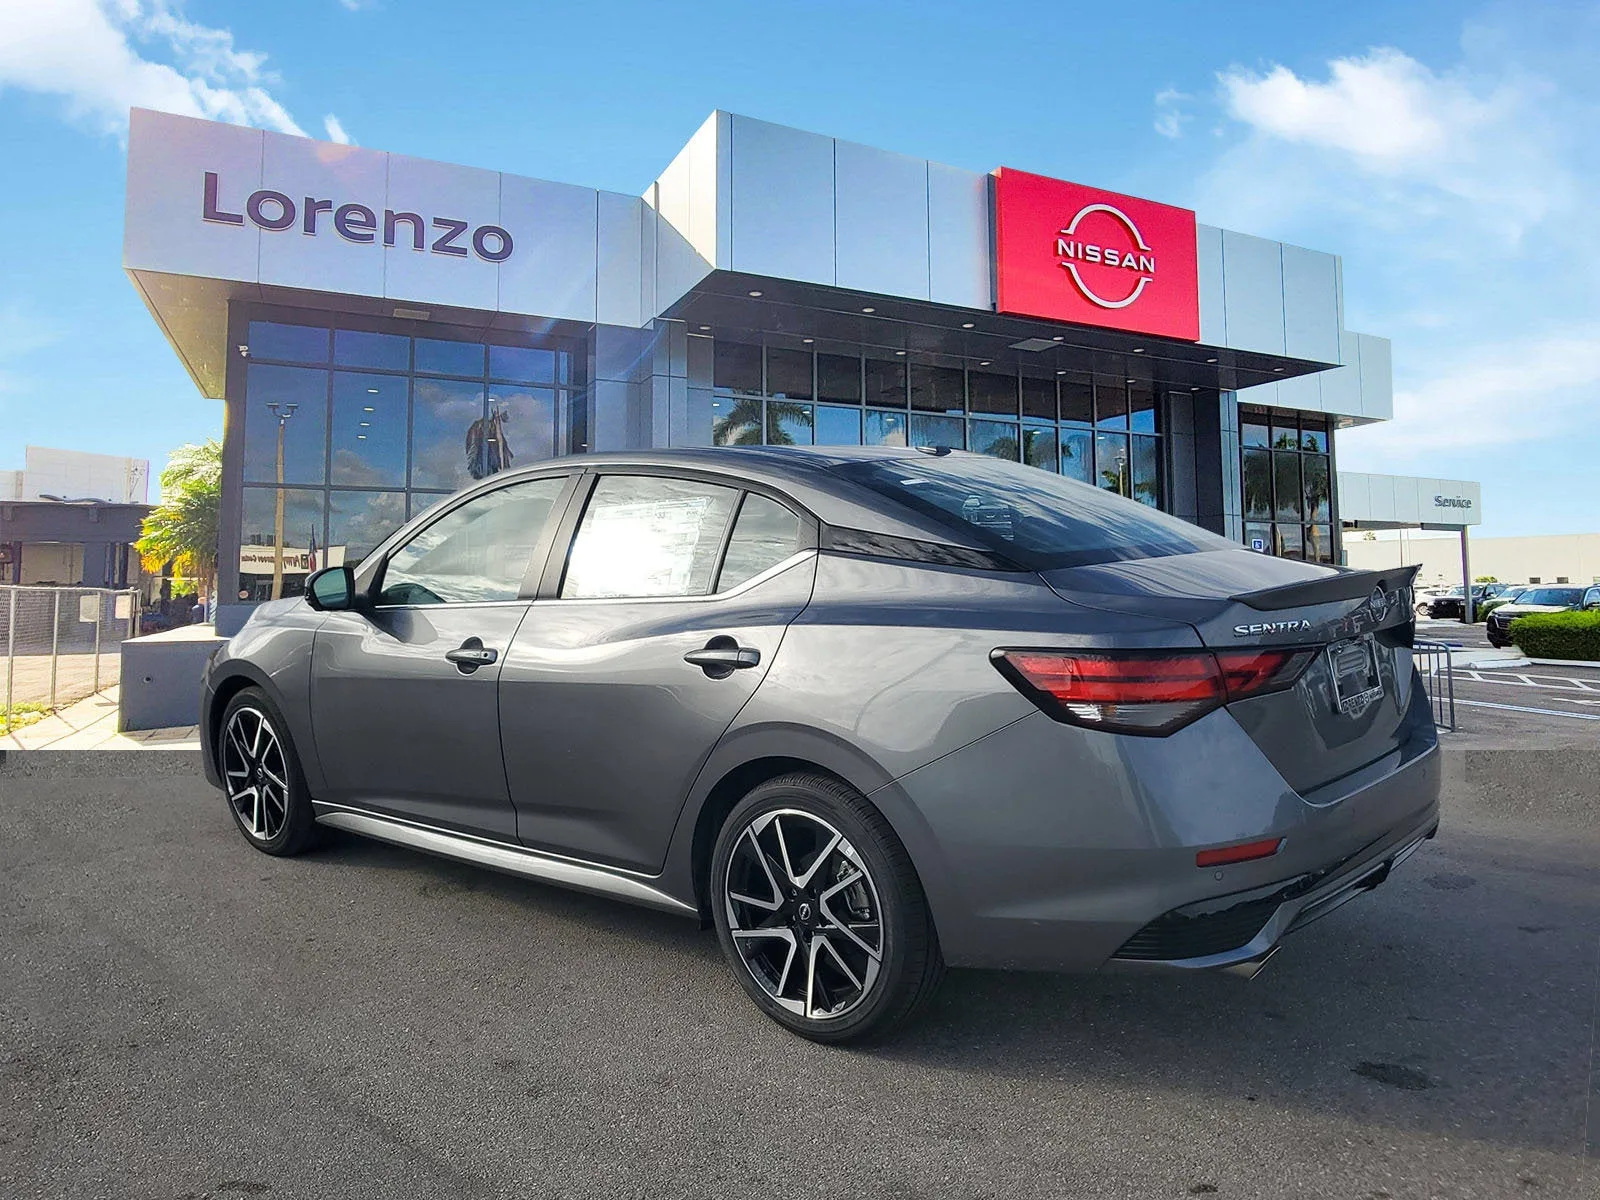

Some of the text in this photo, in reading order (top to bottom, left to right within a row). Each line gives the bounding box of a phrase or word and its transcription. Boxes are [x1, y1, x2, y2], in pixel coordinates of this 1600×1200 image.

[202, 171, 514, 263] Lorenzo
[1057, 238, 1155, 273] NISSAN
[1434, 495, 1472, 509] Service
[1233, 619, 1312, 637] SENTRA
